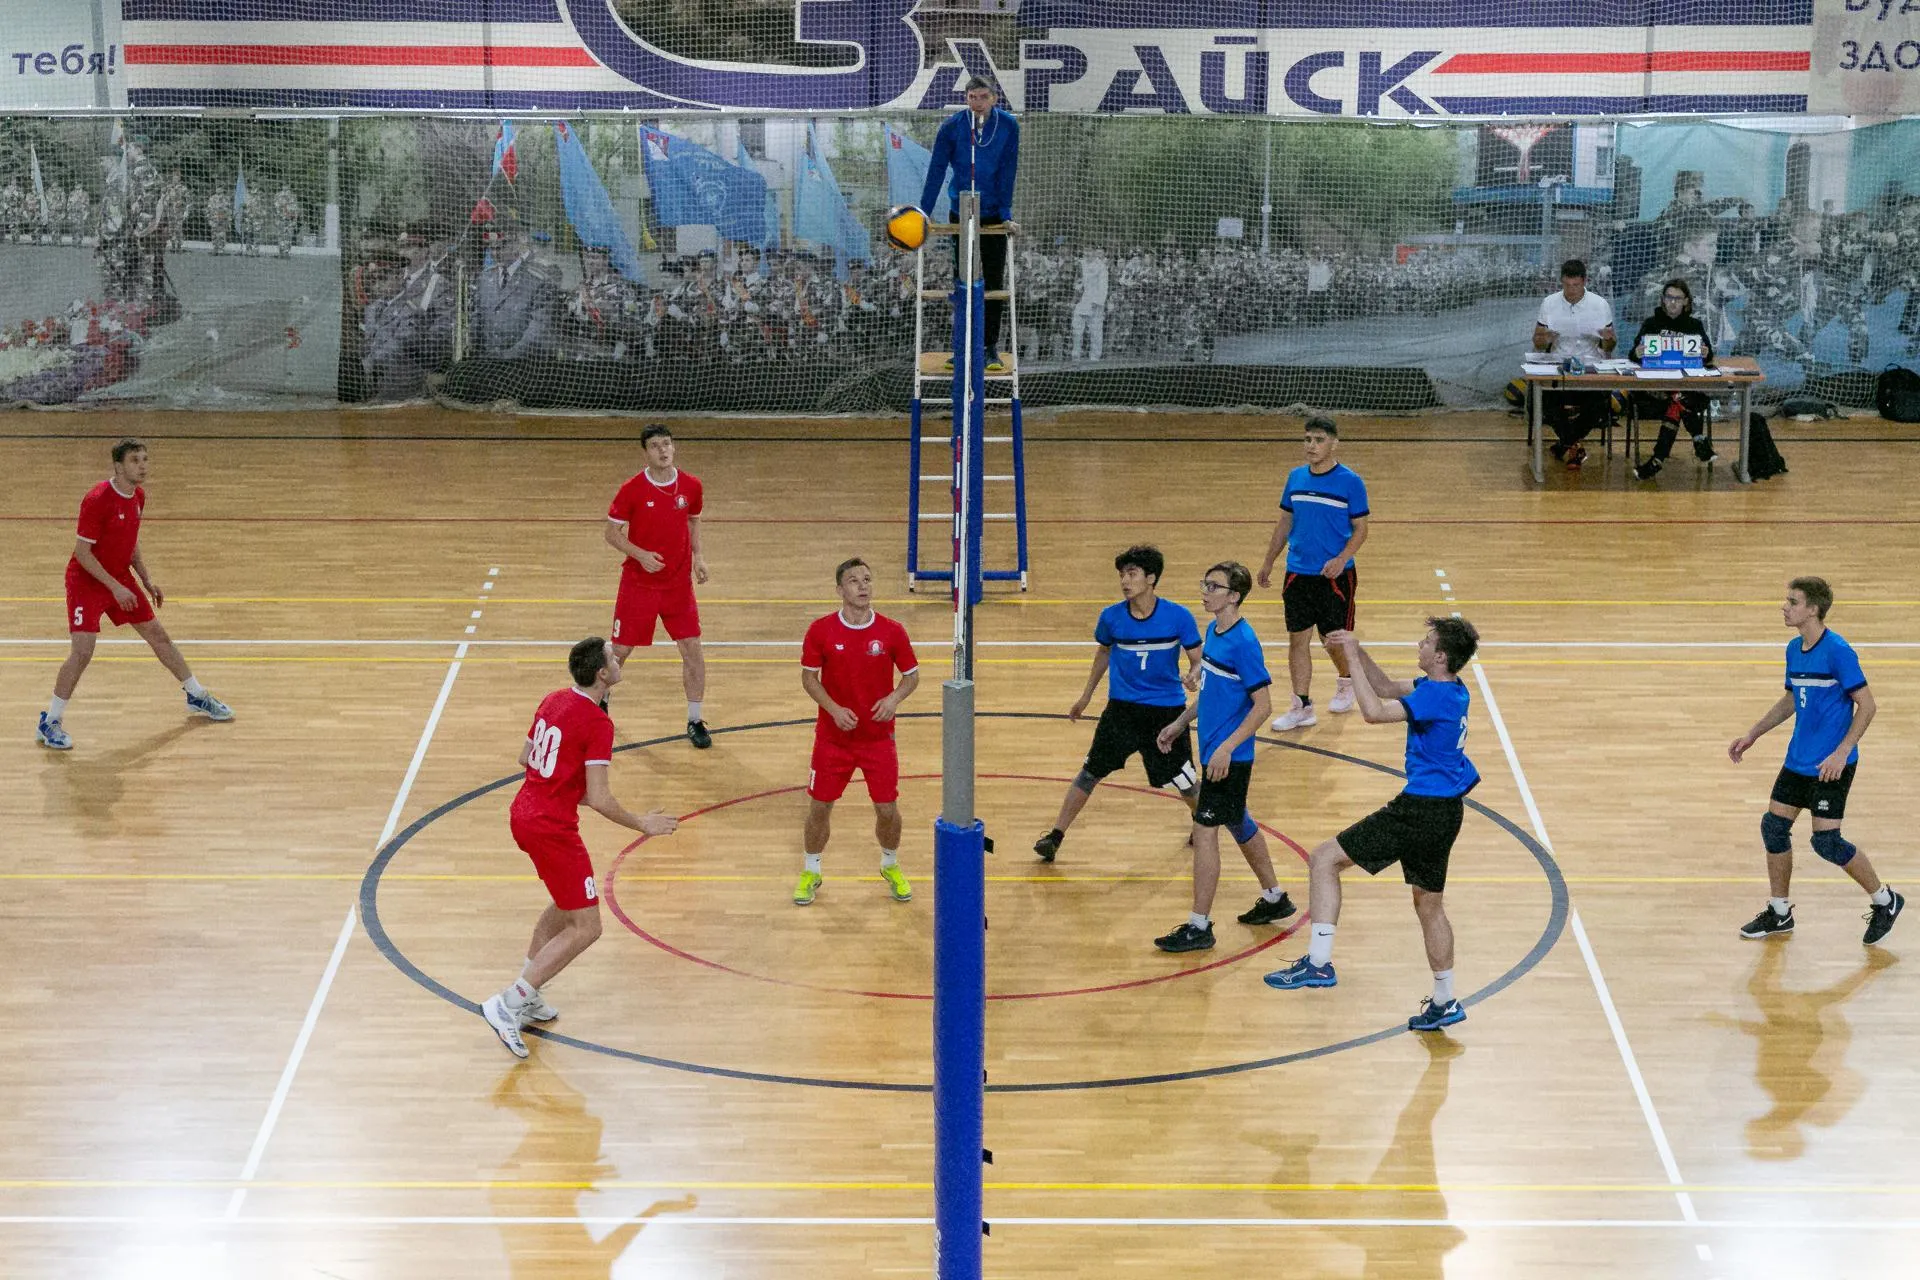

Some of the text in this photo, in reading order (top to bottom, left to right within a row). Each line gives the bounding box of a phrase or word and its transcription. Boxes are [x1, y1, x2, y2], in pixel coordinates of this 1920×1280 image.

[12, 44, 116, 75] тебя!
[1839, 40, 1920, 72] ЗДО
[1648, 339, 1658, 354] 5
[1687, 339, 1698, 353] 2
[74, 606, 84, 626] 5
[613, 619, 621, 638] 9
[1136, 651, 1149, 671] 7
[1799, 686, 1807, 709] 5
[1456, 715, 1467, 750] 2
[528, 718, 562, 779] 80
